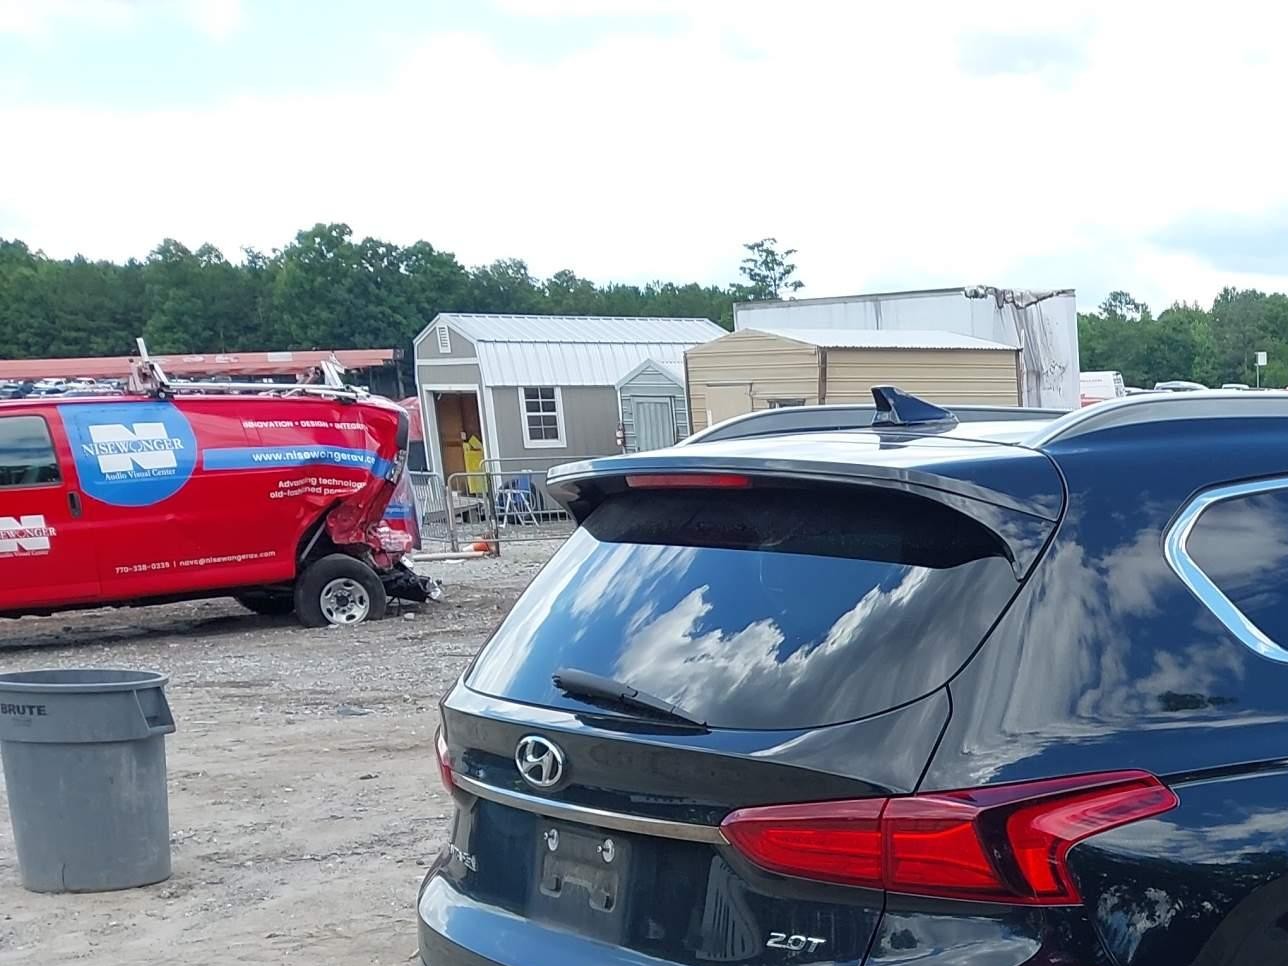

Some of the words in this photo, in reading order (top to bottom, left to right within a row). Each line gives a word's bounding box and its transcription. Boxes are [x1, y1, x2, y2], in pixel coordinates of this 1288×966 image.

[242, 420, 294, 429] INNOVATION
[300, 420, 329, 429] DESIGN
[82, 438, 184, 457] NISEWONGER
[105, 472, 127, 480] Audio
[128, 471, 151, 479] Visual
[152, 468, 176, 478] Center
[278, 477, 317, 489] Advancing
[0, 703, 48, 716] BRUTE
